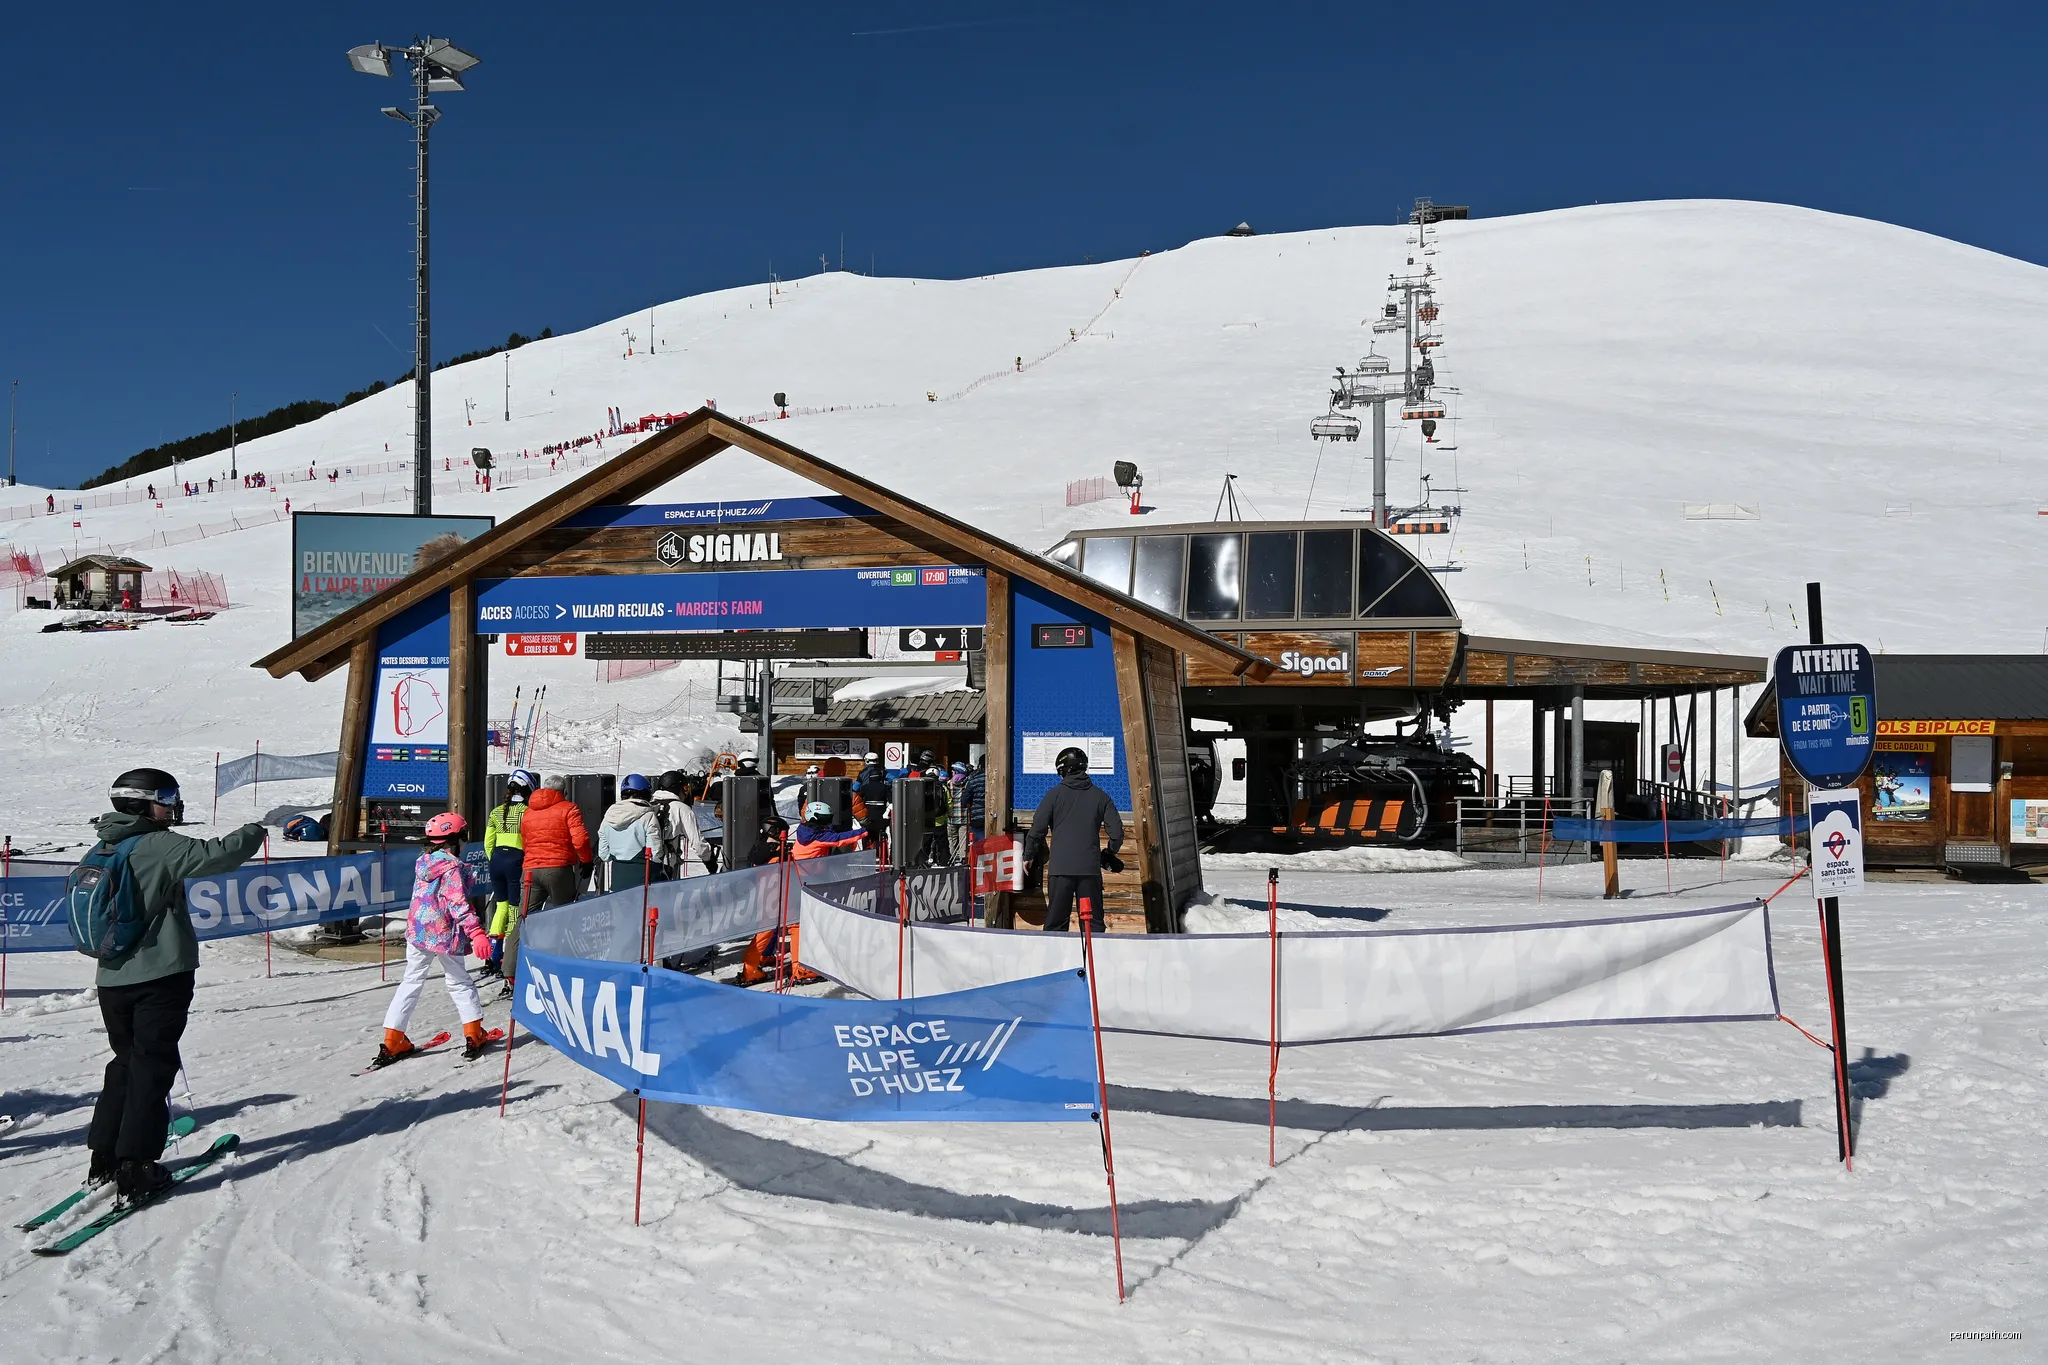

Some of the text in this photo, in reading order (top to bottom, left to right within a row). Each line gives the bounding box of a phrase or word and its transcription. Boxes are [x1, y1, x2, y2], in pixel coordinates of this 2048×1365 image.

[665, 510, 695, 518] ESPACE
[696, 509, 716, 517] ALPE
[689, 533, 783, 563] SIGNAL
[303, 551, 409, 574] BIENVENUE
[857, 568, 984, 582] OUVERTURE 9:00 17:00 FERMETURE
[315, 577, 358, 593] L'ALPE
[480, 606, 512, 620] ACCES
[515, 605, 550, 619] ACCESS
[572, 604, 615, 618] VILLARD
[617, 602, 665, 618] RECULAS
[675, 601, 728, 616] MARCEL'S
[731, 600, 763, 615] FARM
[520, 635, 540, 643] PASSAGE
[524, 645, 558, 653] ECOLES DE SKI
[381, 657, 398, 665] PISTES
[431, 657, 450, 665] SLOPES
[1280, 652, 1348, 675] Signal
[1792, 649, 1859, 673] ATTENTE
[1799, 673, 1856, 694] WAIT TIME
[1808, 703, 1830, 715] PARTIR
[1852, 703, 1861, 728] 5
[1792, 719, 1831, 732] DE CE POINT
[1915, 722, 1991, 733] BIPLACE
[1794, 739, 1832, 749] FROM THIS POINT
[1846, 734, 1869, 746] minutes
[1894, 742, 1924, 751] CADEAU
[1827, 860, 1849, 868] espace
[1821, 867, 1855, 877] sans tabac
[189, 861, 395, 930] SIGNAL
[834, 1020, 950, 1048] ESPACE
[847, 1049, 921, 1073] ALPE
[850, 1068, 965, 1097] D'HUEZ
